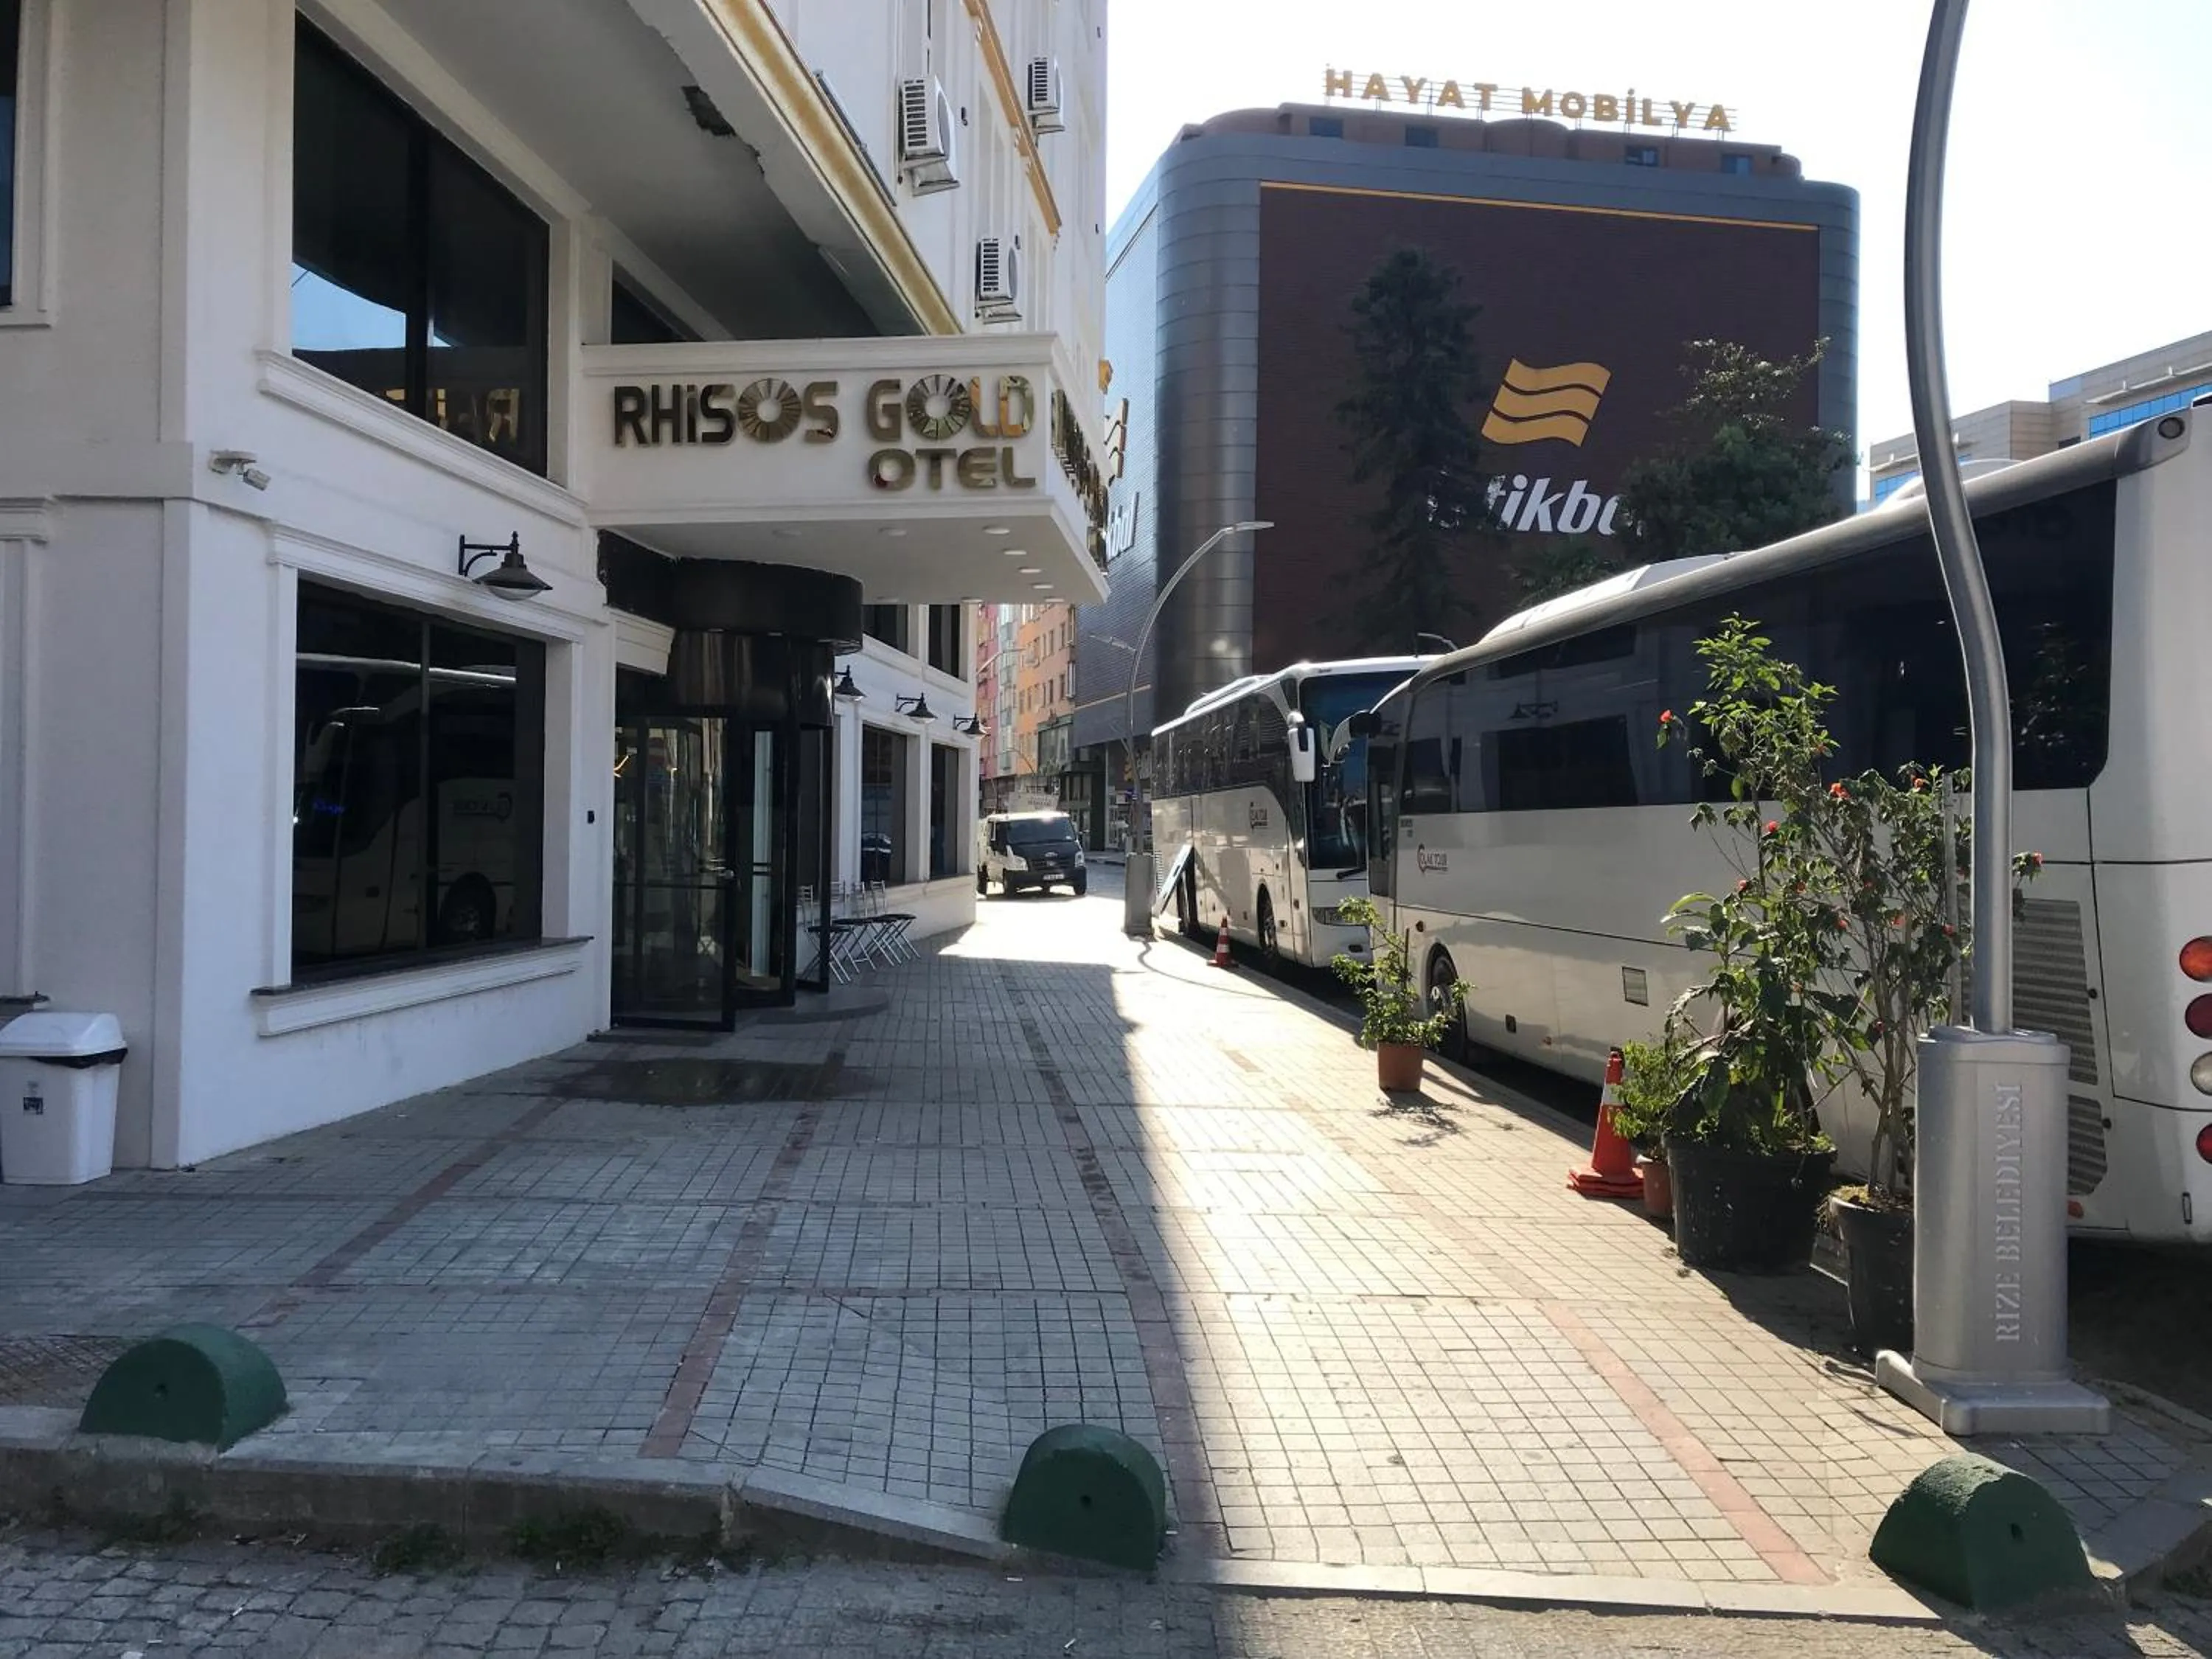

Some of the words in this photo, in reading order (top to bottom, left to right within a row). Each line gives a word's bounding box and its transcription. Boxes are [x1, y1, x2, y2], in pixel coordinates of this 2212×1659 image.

[1325, 69, 1498, 111] HAYAT
[1522, 86, 1731, 131] MOBİLYA
[866, 374, 1034, 442] GOLD
[868, 446, 1036, 491] OTEL
